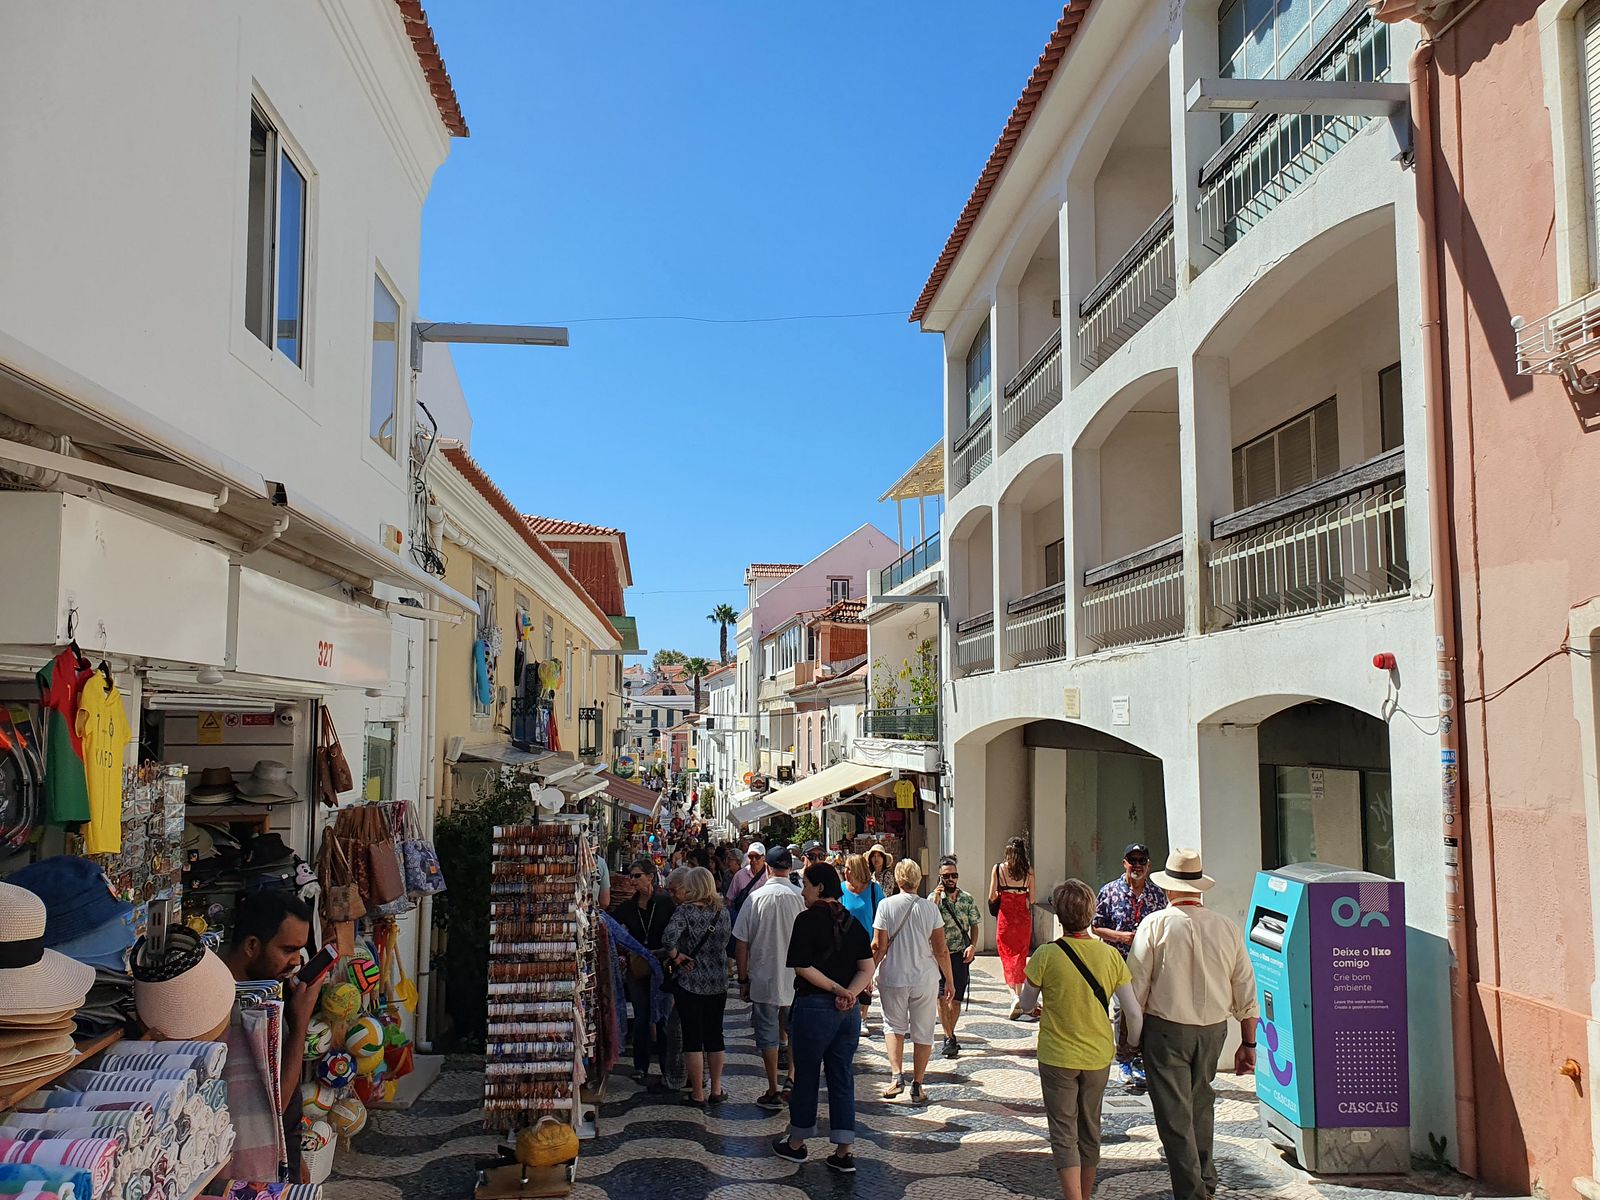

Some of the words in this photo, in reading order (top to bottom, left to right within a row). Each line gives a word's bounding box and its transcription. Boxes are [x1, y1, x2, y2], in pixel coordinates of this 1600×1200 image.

[317, 640, 334, 668] 327
[1332, 947, 1361, 957] Deixe
[1362, 949, 1370, 957] o
[1371, 947, 1392, 957] lixo
[1332, 959, 1370, 969] comigo
[1333, 973, 1350, 981] Crie
[1351, 973, 1371, 981] bom
[1333, 983, 1372, 992] ambiente
[1338, 1101, 1398, 1114] CASCAIS
